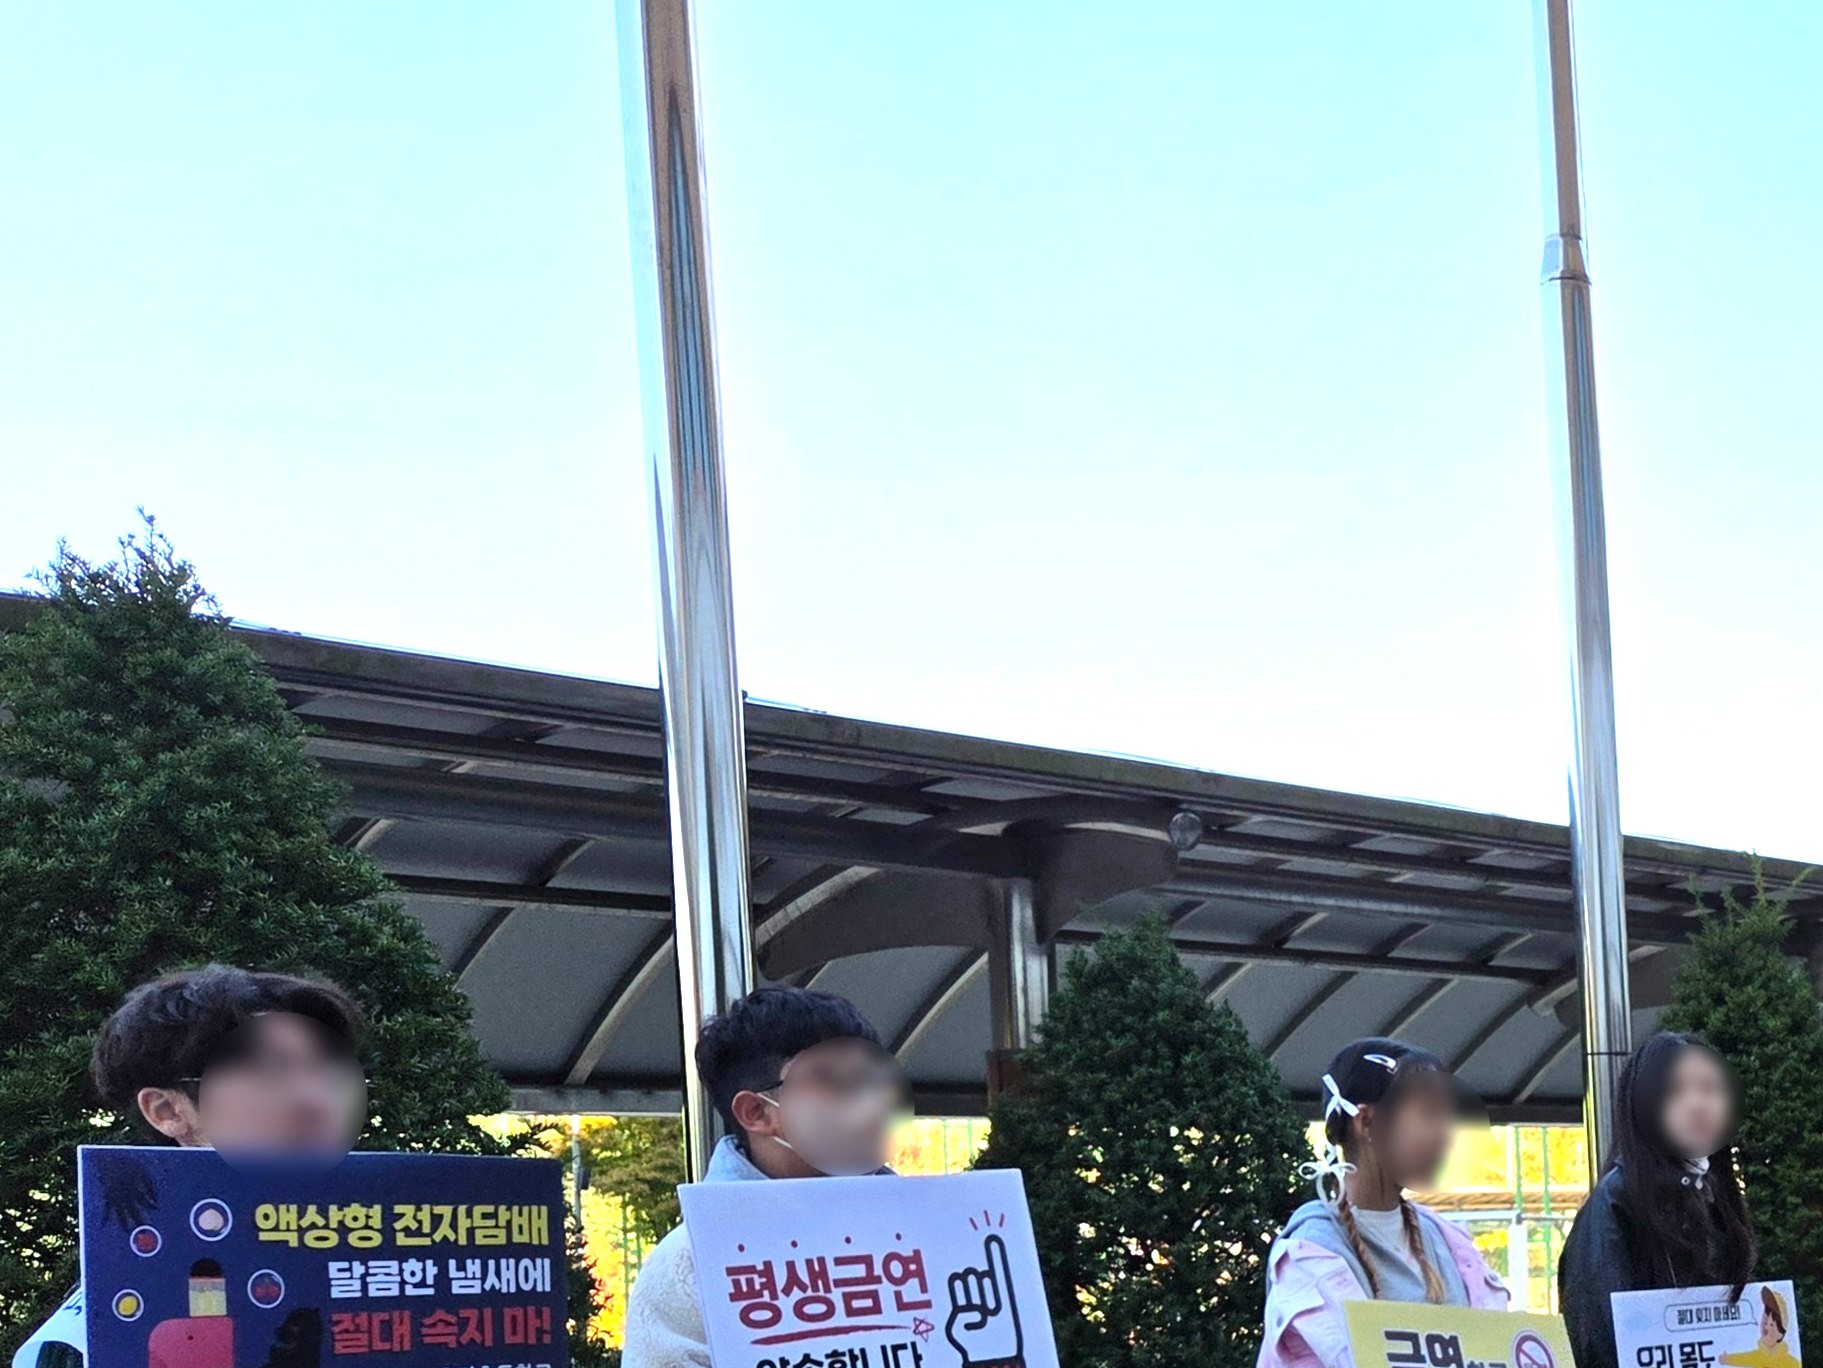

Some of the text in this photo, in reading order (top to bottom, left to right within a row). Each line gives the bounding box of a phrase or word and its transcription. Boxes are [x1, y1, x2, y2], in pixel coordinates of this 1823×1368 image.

[255, 1203, 549, 1249] 액상형 전자담배
[328, 1257, 552, 1299] 달콤한 냄새에
[725, 1248, 933, 1329] 평생금연
[329, 1307, 553, 1355] 절대 속지 마!
